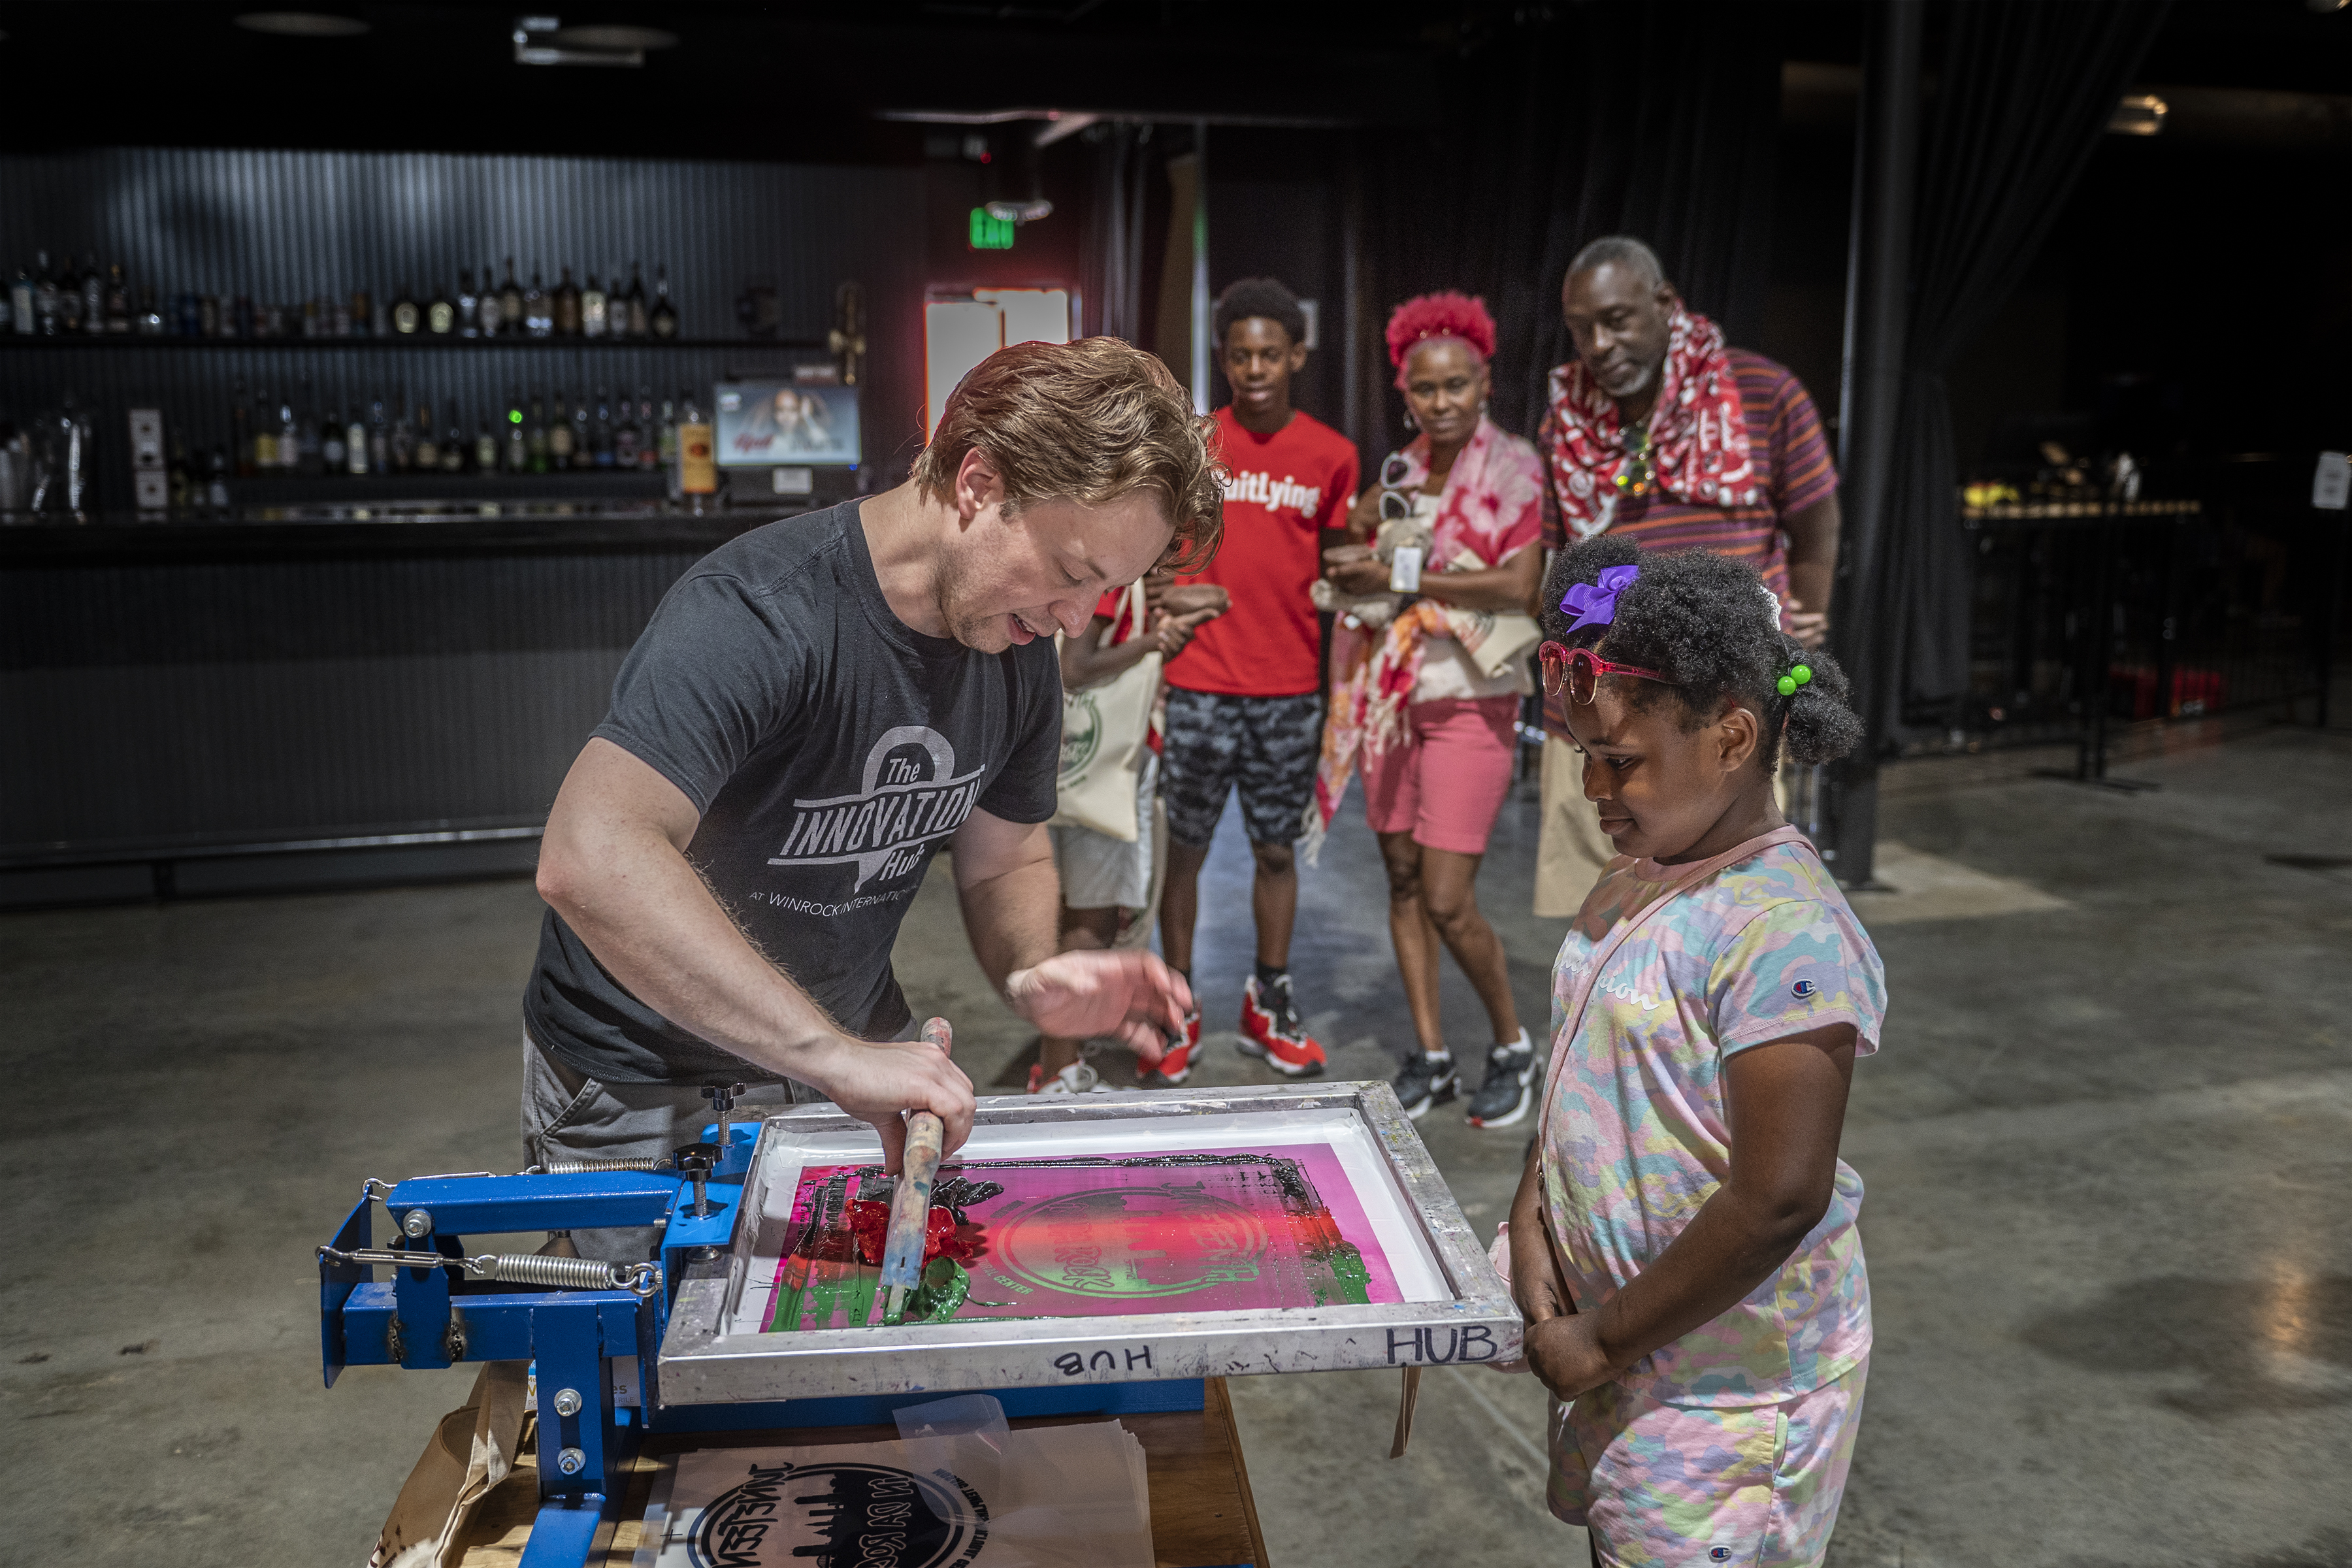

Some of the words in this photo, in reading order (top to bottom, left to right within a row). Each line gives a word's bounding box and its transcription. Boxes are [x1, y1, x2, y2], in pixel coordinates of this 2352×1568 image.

[1213, 469, 1321, 519] uitLying
[886, 758, 920, 783] The
[779, 778, 980, 856] INNOVATION
[879, 843, 924, 881] Hub
[749, 891, 765, 901] AT
[769, 892, 842, 917] WINROCK
[993, 1275, 1034, 1295] CENTER
[1054, 1245, 1115, 1289] ROCK
[1386, 1326, 1499, 1365] HUB
